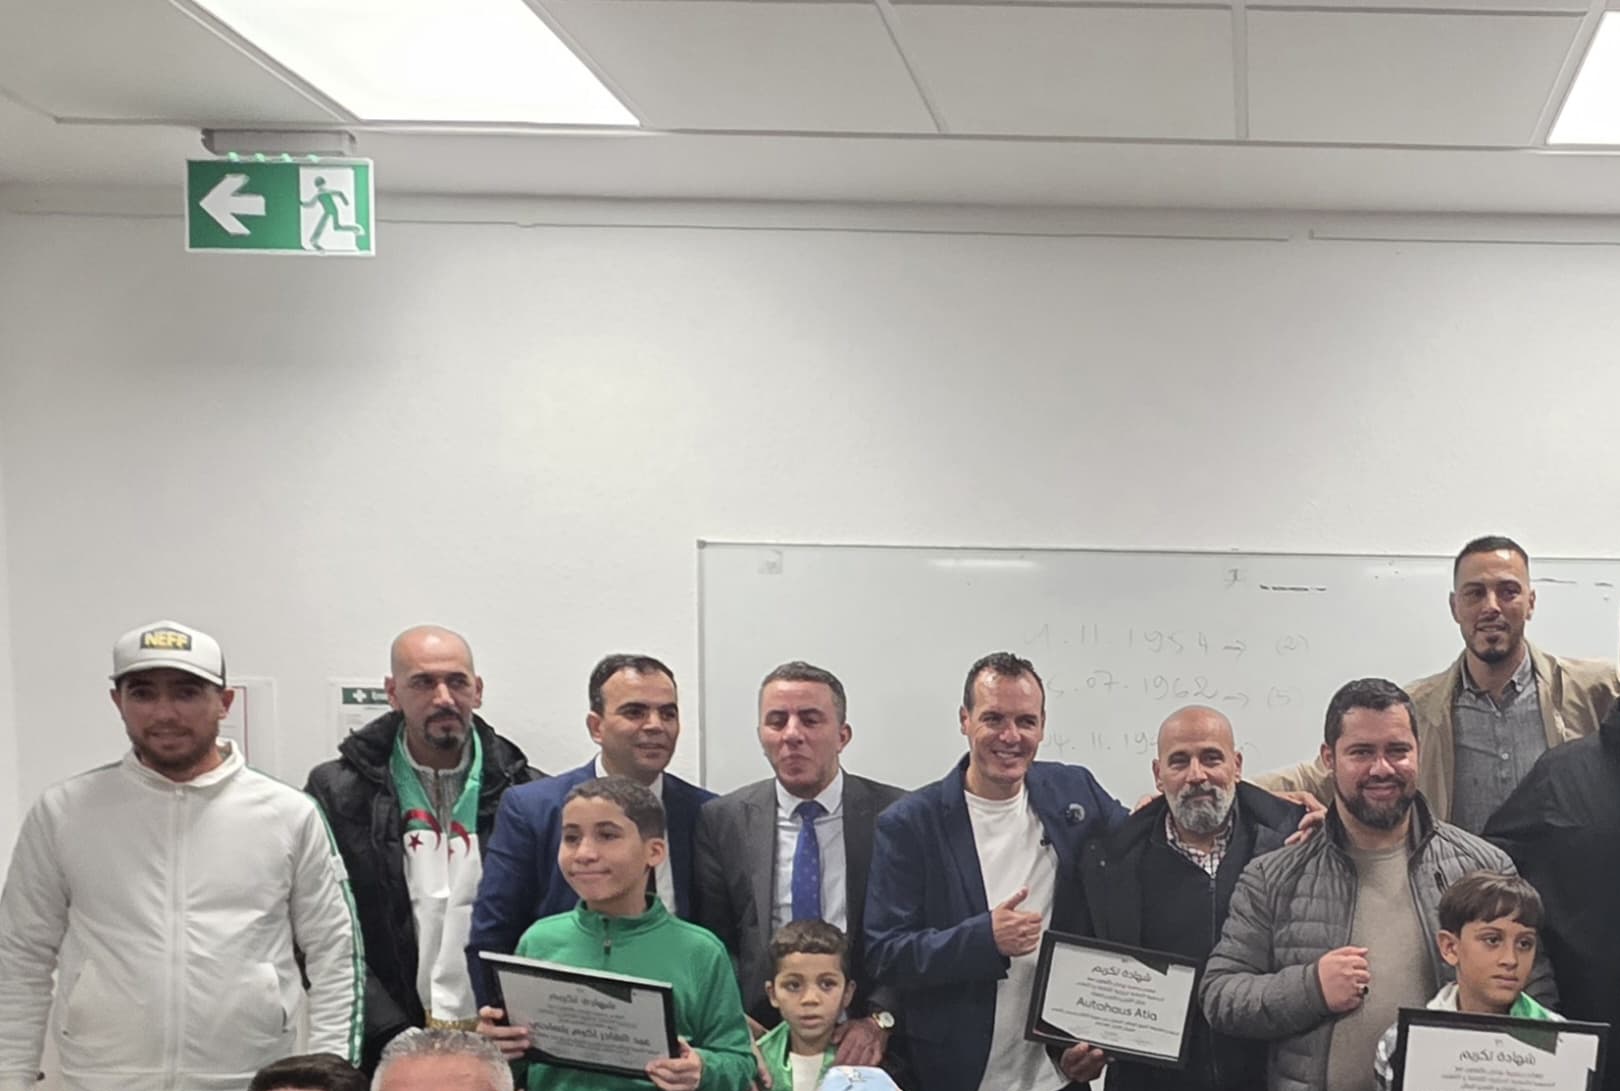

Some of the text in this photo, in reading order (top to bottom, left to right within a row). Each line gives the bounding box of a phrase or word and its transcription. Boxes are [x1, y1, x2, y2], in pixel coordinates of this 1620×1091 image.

[144, 631, 188, 648] NEFF
[1076, 997, 1132, 1017] Autohaus
[1134, 1007, 1158, 1022] Atia
